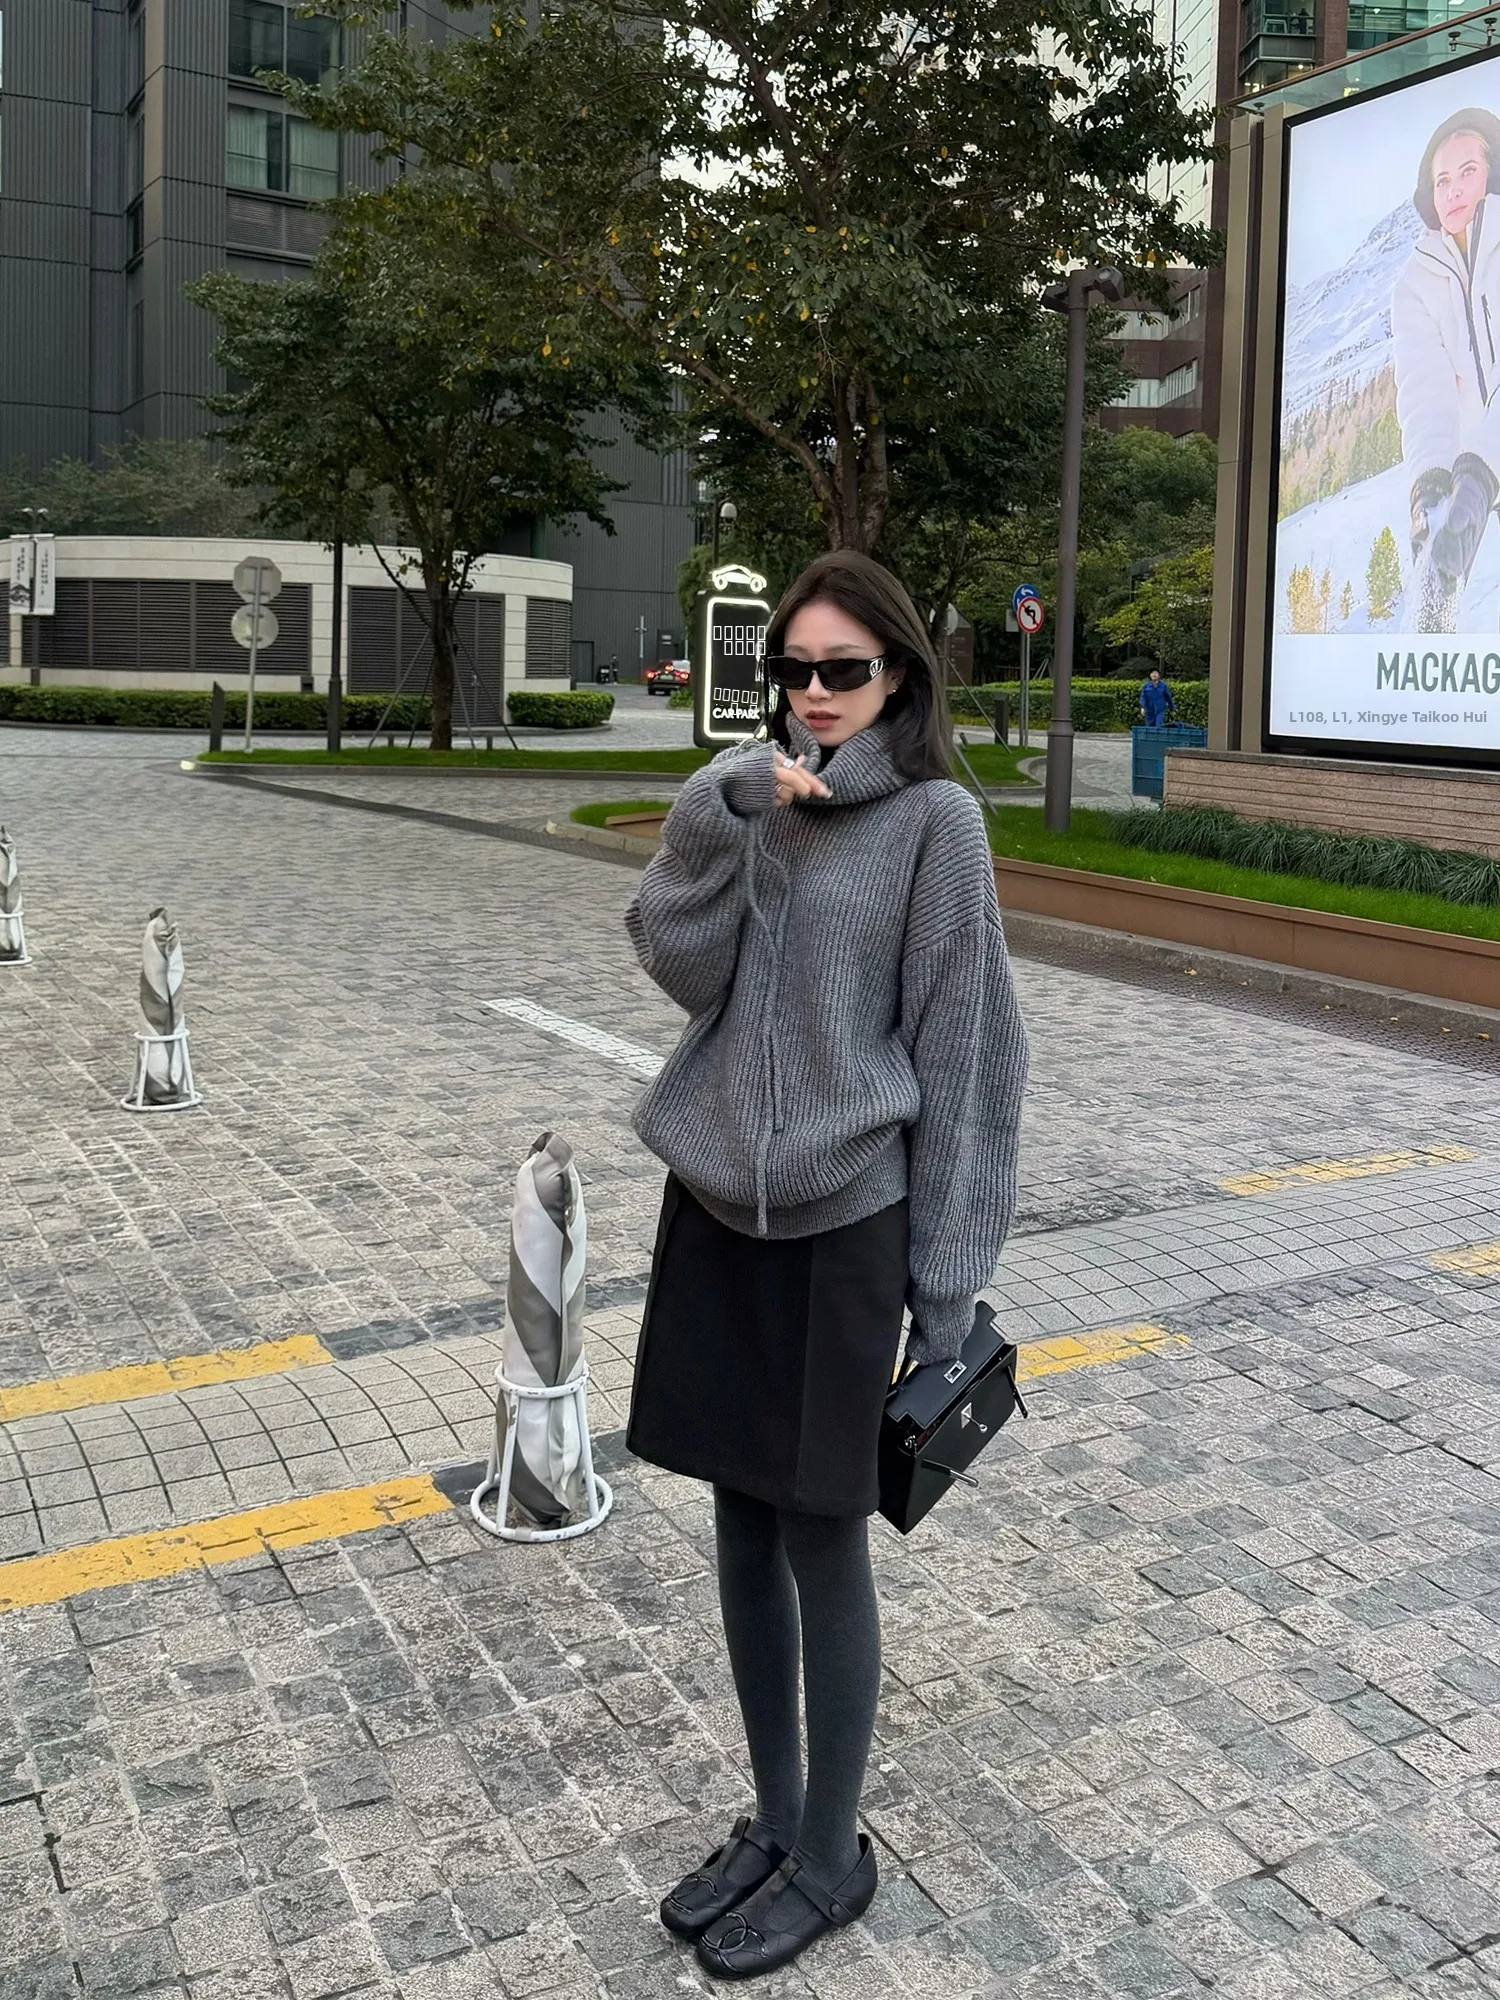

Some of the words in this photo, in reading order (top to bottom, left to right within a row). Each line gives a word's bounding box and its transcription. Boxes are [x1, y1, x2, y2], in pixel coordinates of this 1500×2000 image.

[1376, 652, 1500, 695] MACKAG
[1289, 711, 1328, 725] L108,
[1332, 711, 1353, 725] L1,
[1357, 711, 1408, 726] Xingye
[1411, 711, 1460, 723] Taikoo
[1463, 711, 1487, 723] Hui
